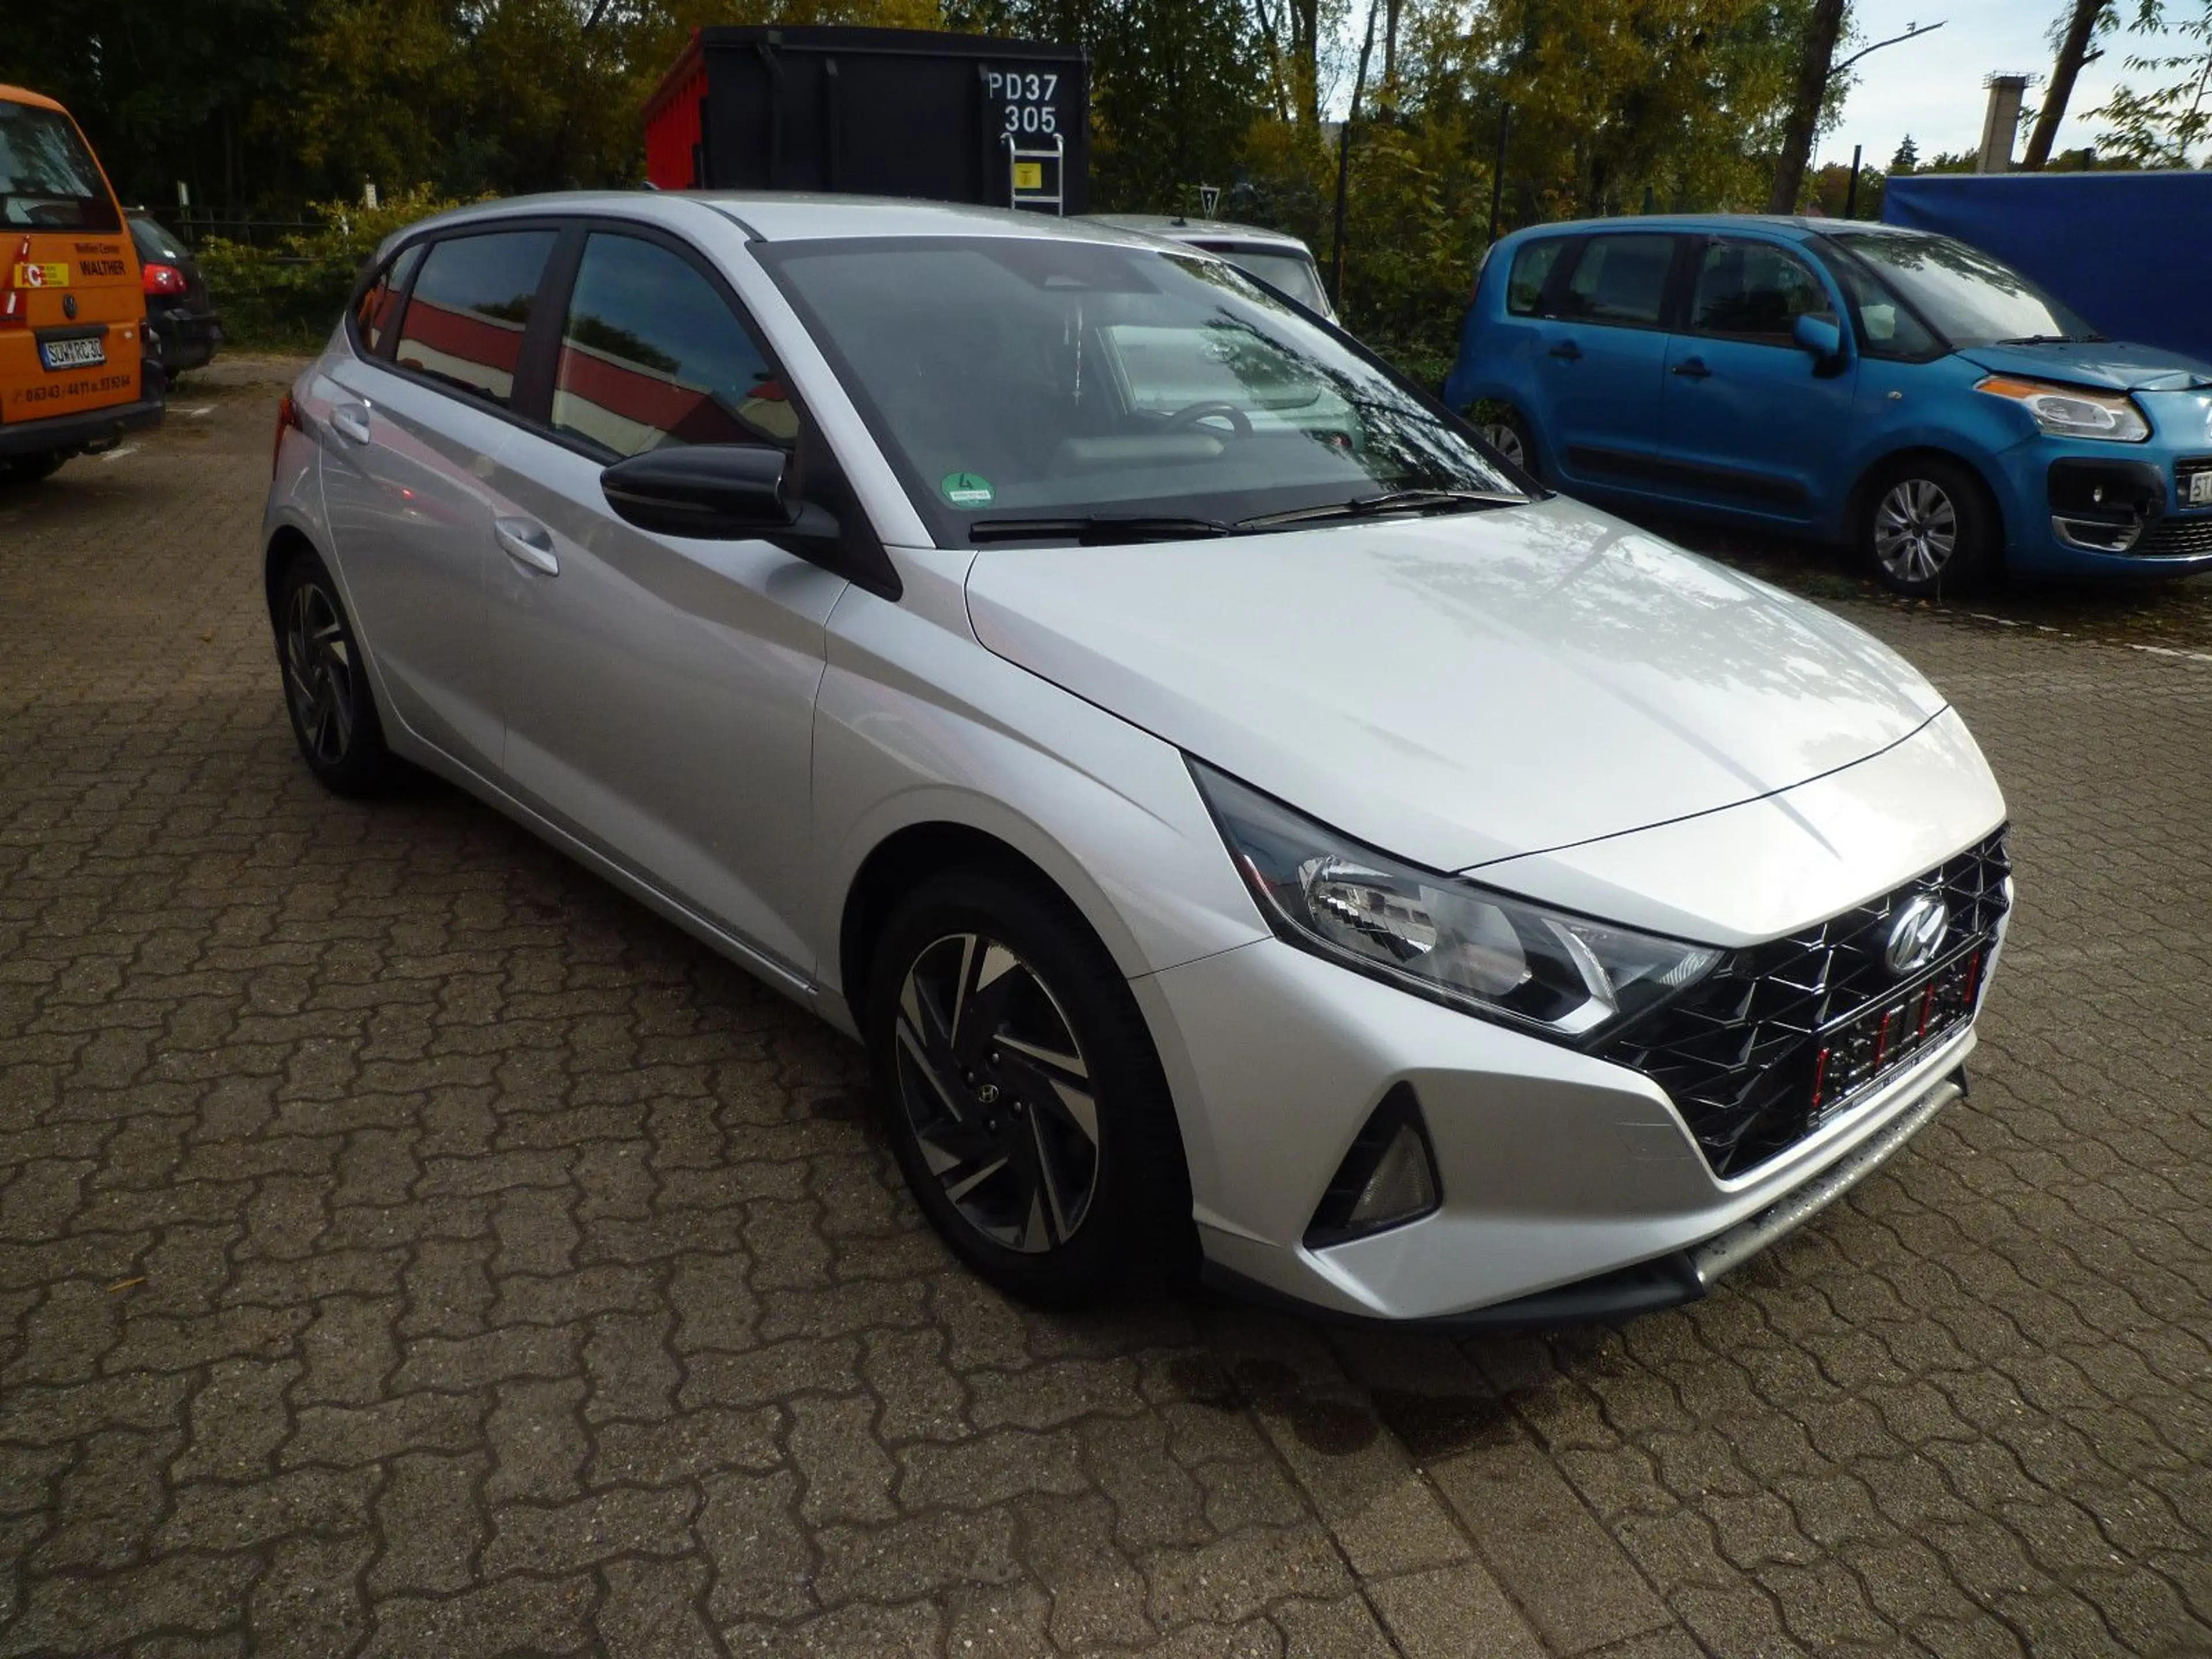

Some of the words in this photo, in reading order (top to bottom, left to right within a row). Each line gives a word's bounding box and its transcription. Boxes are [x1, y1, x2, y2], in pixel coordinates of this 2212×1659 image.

[988, 73, 1058, 100] PD37
[1005, 105, 1056, 133] 305
[79, 260, 125, 276] WALTHER
[959, 473, 974, 490] 4
